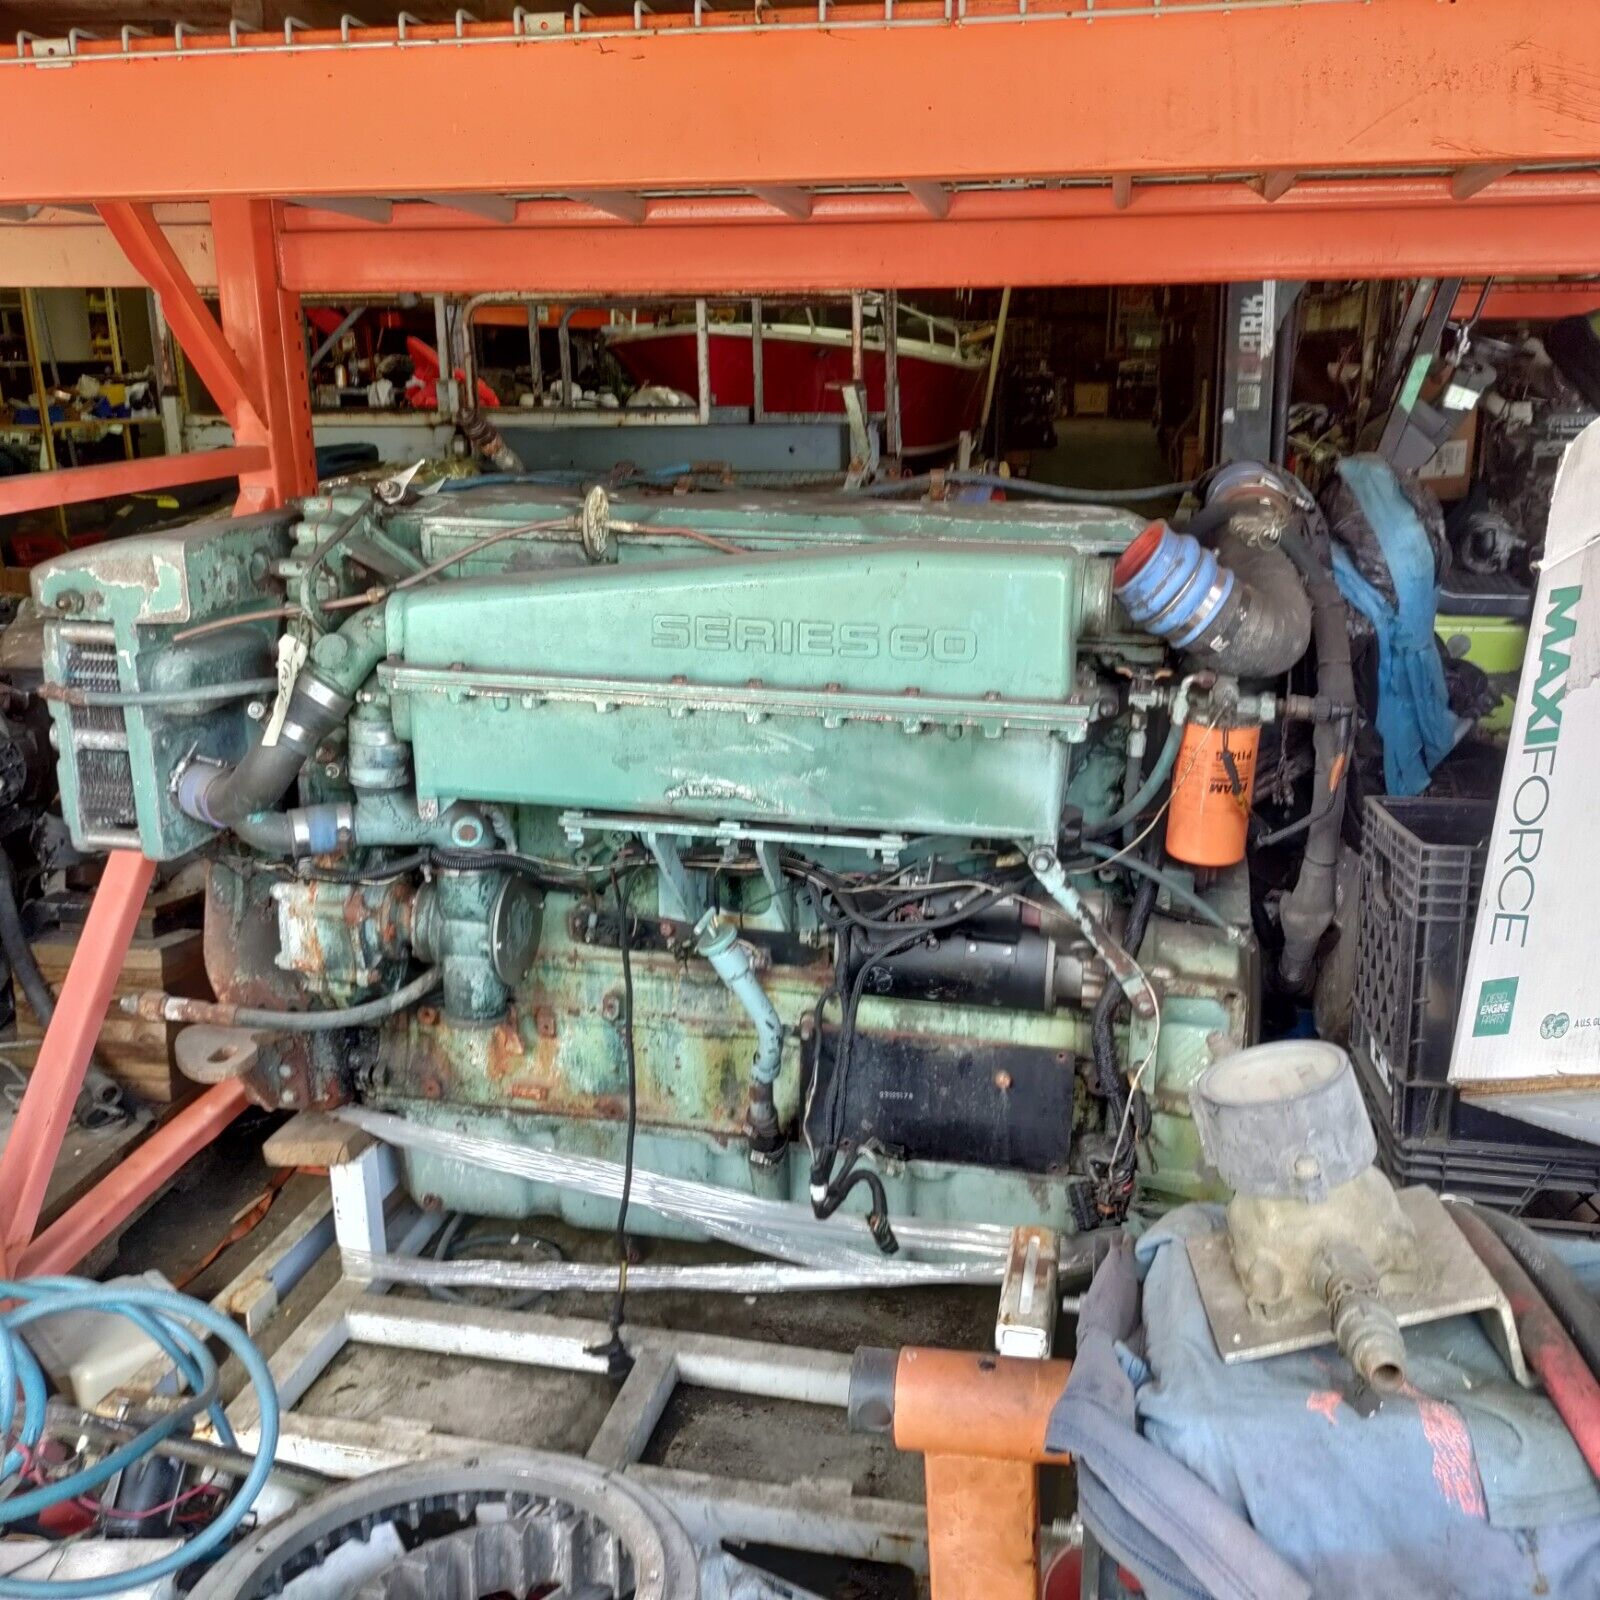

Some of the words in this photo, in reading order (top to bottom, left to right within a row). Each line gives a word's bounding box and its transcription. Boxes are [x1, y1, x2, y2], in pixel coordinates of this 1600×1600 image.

[651, 614, 880, 660] SERIES
[890, 625, 977, 663] 60
[1490, 584, 1583, 949] MAXIFORCE
[1209, 782, 1248, 795] FAM
[1480, 1002, 1510, 1015] ENGINE
